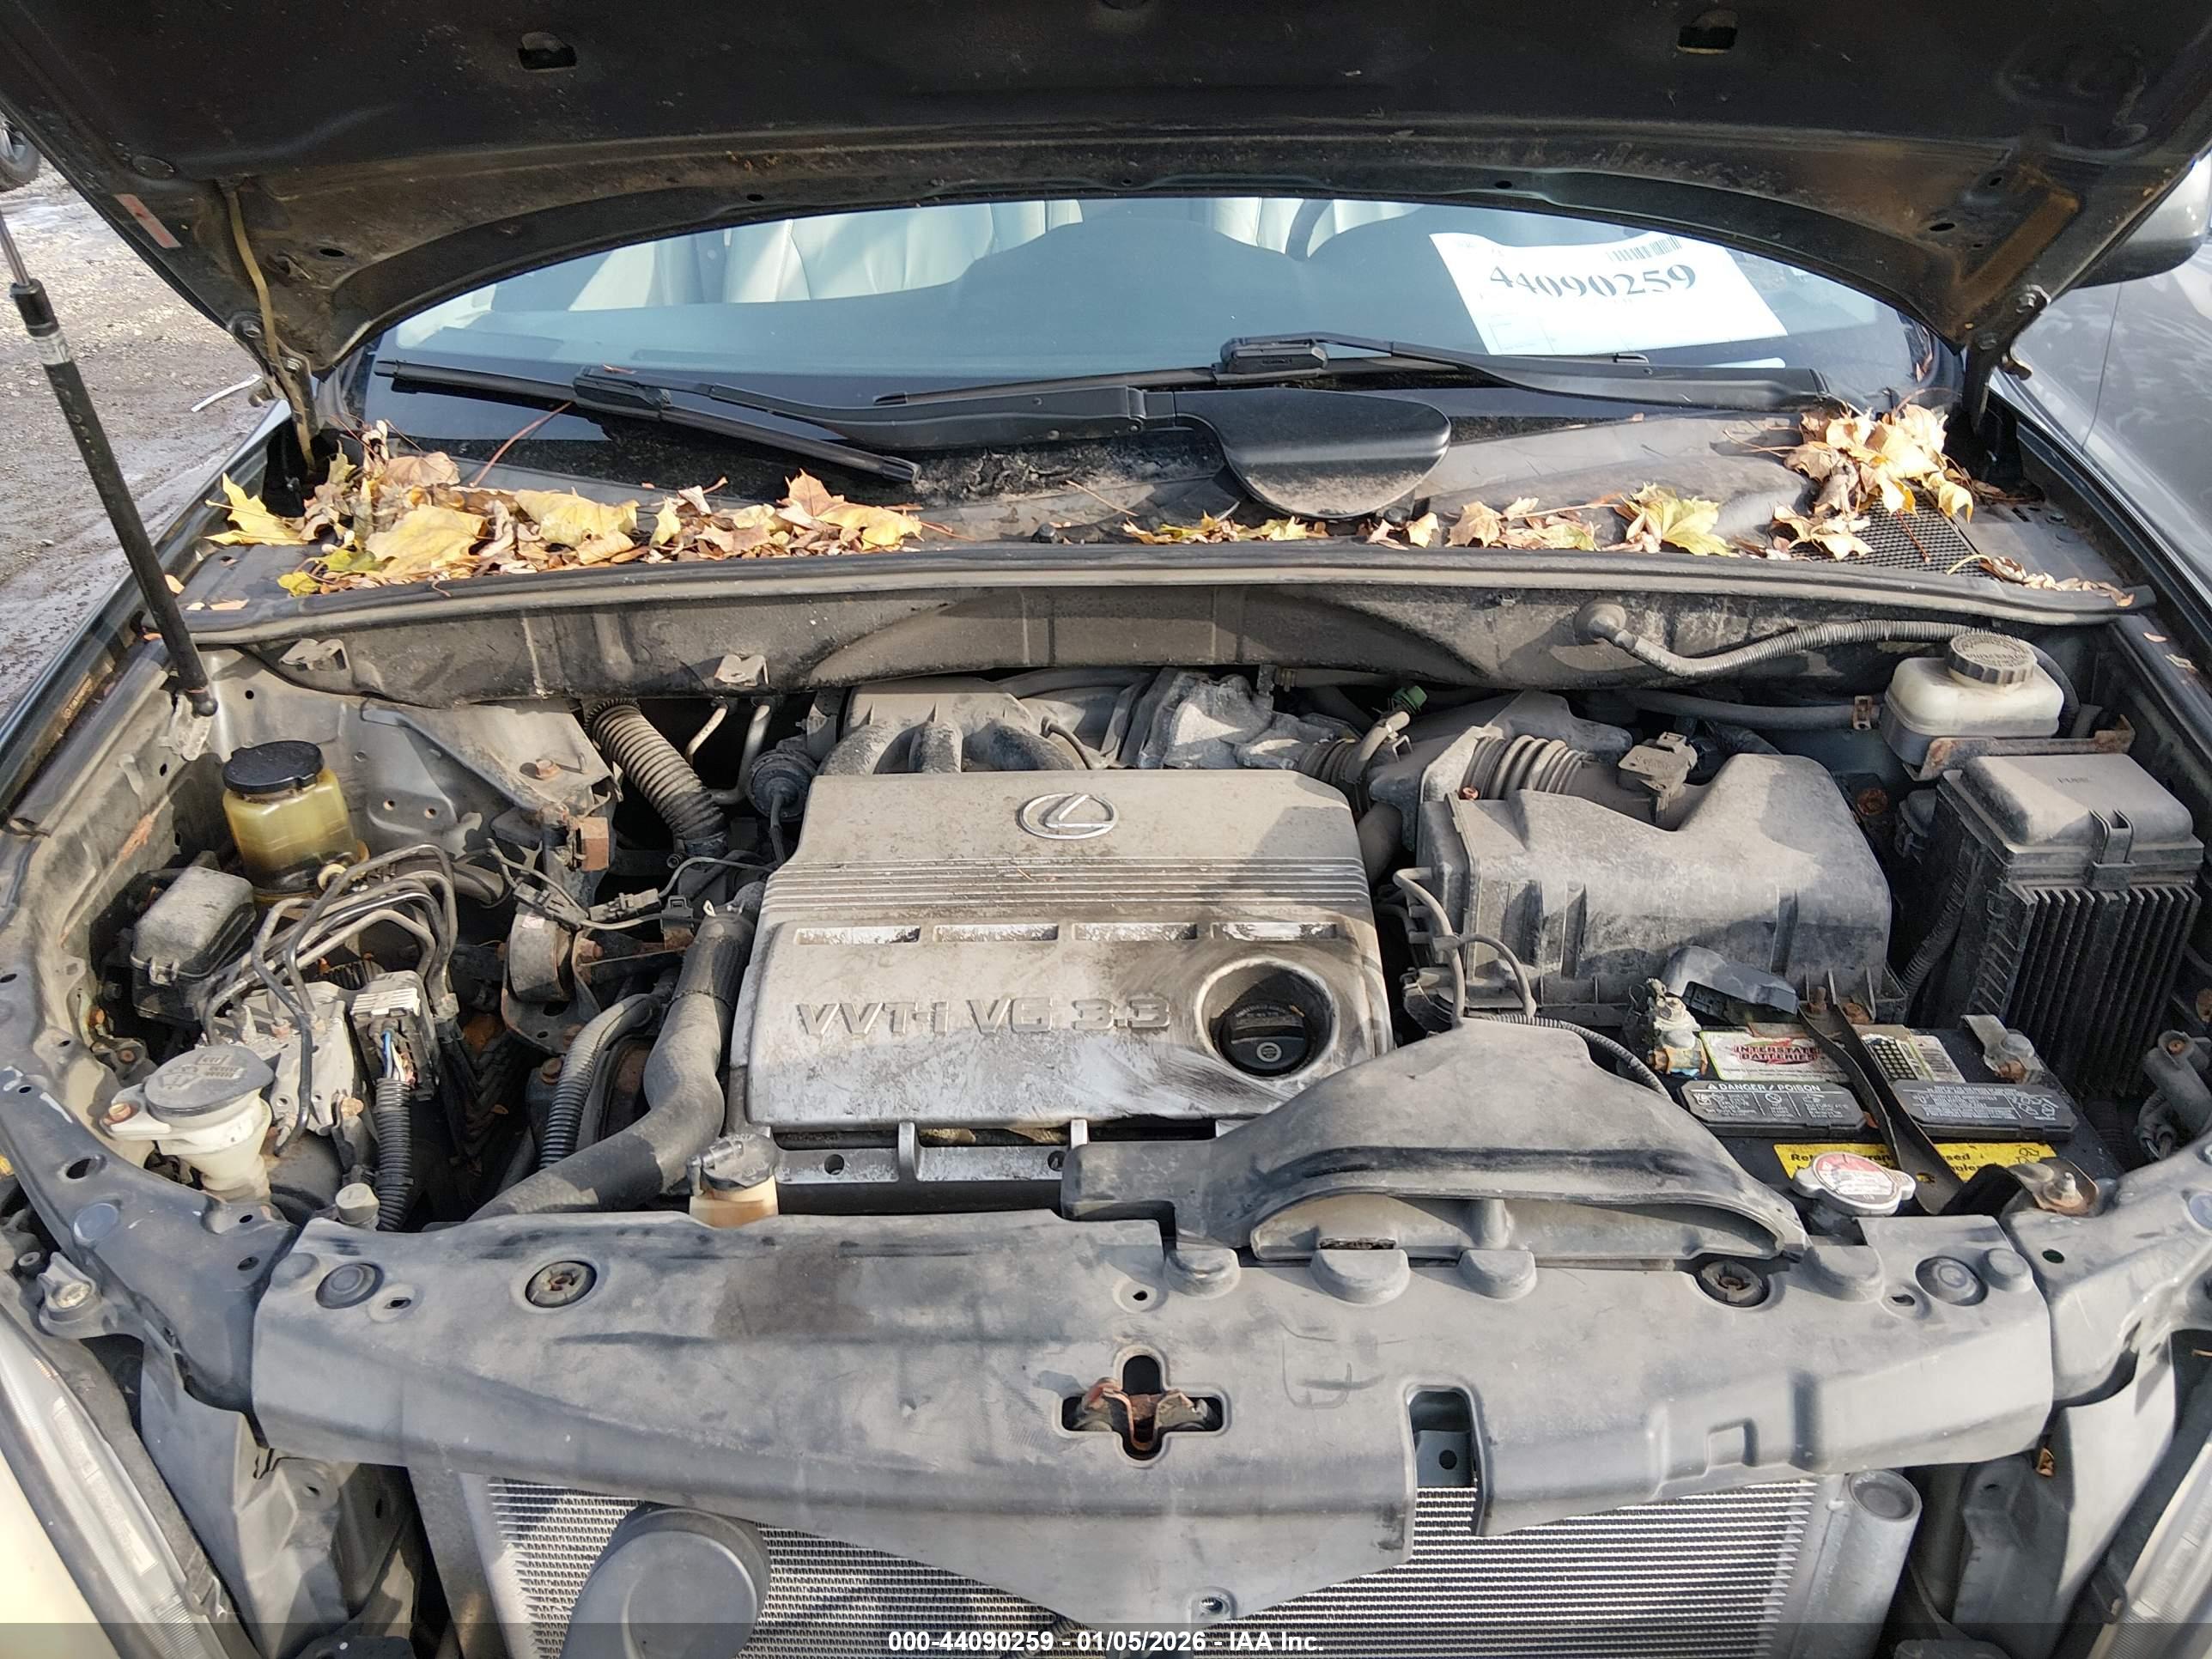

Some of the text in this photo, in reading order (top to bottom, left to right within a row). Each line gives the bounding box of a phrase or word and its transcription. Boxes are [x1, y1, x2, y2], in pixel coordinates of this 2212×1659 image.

[1490, 264, 1696, 297] 44090259
[967, 997, 1053, 1034] V6
[1072, 998, 1171, 1032] 3.3
[1734, 1045, 1818, 1054] INTERSTATE
[1718, 1083, 1766, 1091] DANGER
